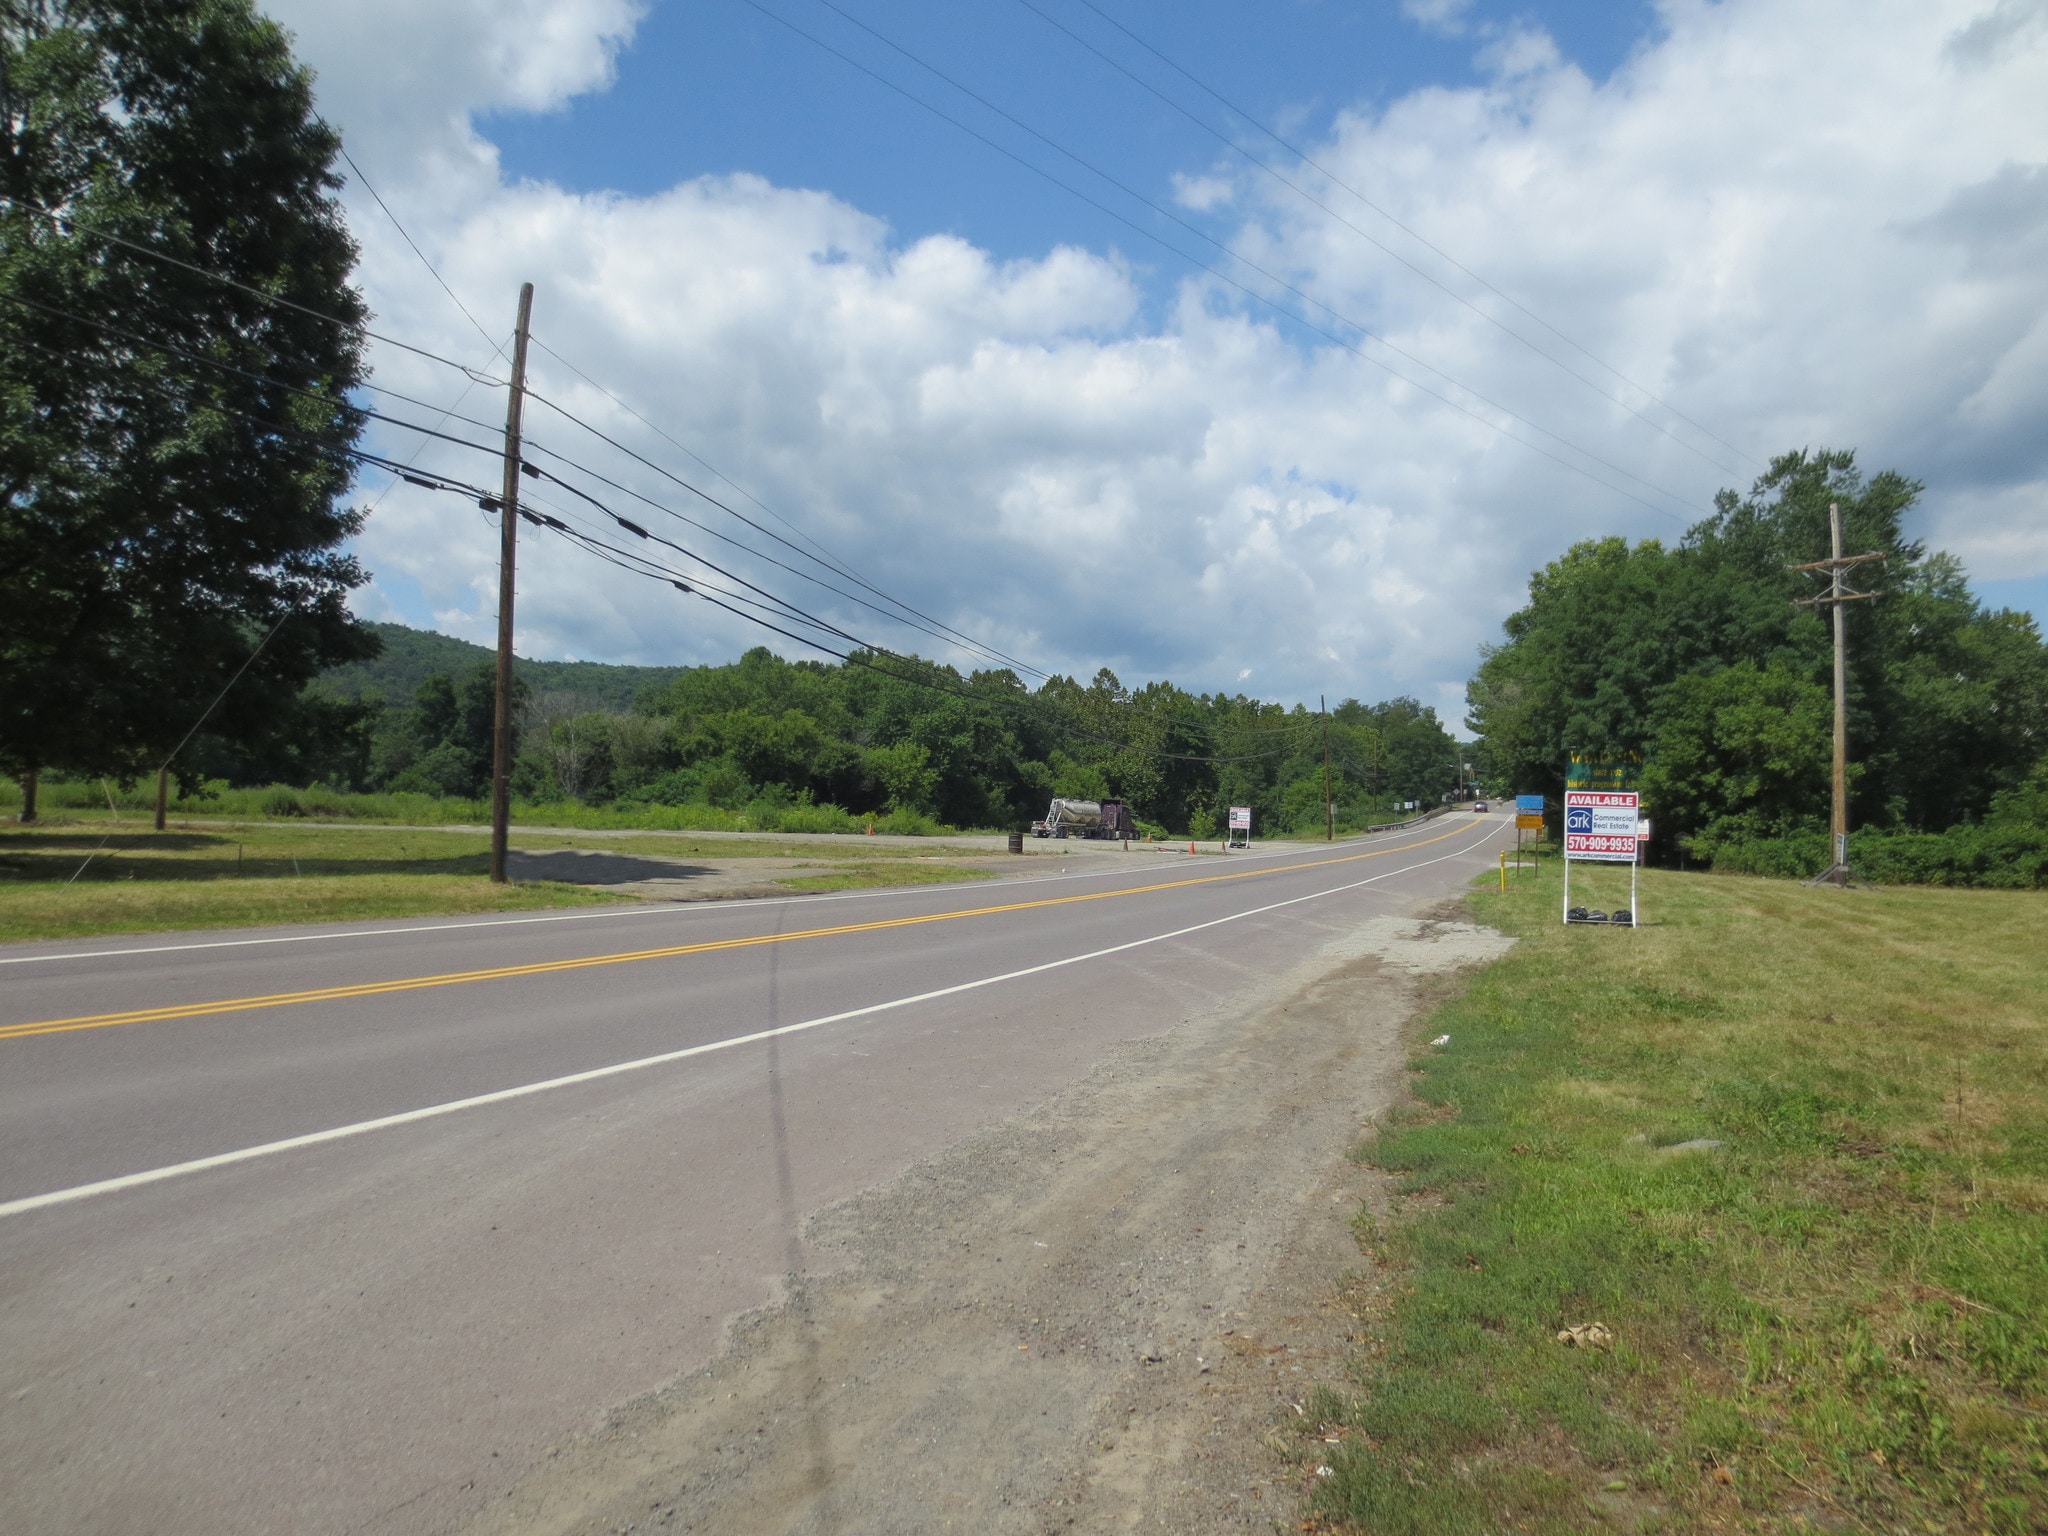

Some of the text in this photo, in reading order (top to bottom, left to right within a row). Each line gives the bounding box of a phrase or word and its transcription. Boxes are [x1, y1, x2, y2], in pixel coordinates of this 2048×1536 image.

[1569, 796, 1633, 806] AVAILABLE
[1568, 814, 1590, 828] ark
[1568, 836, 1634, 851] 570-909-9935
